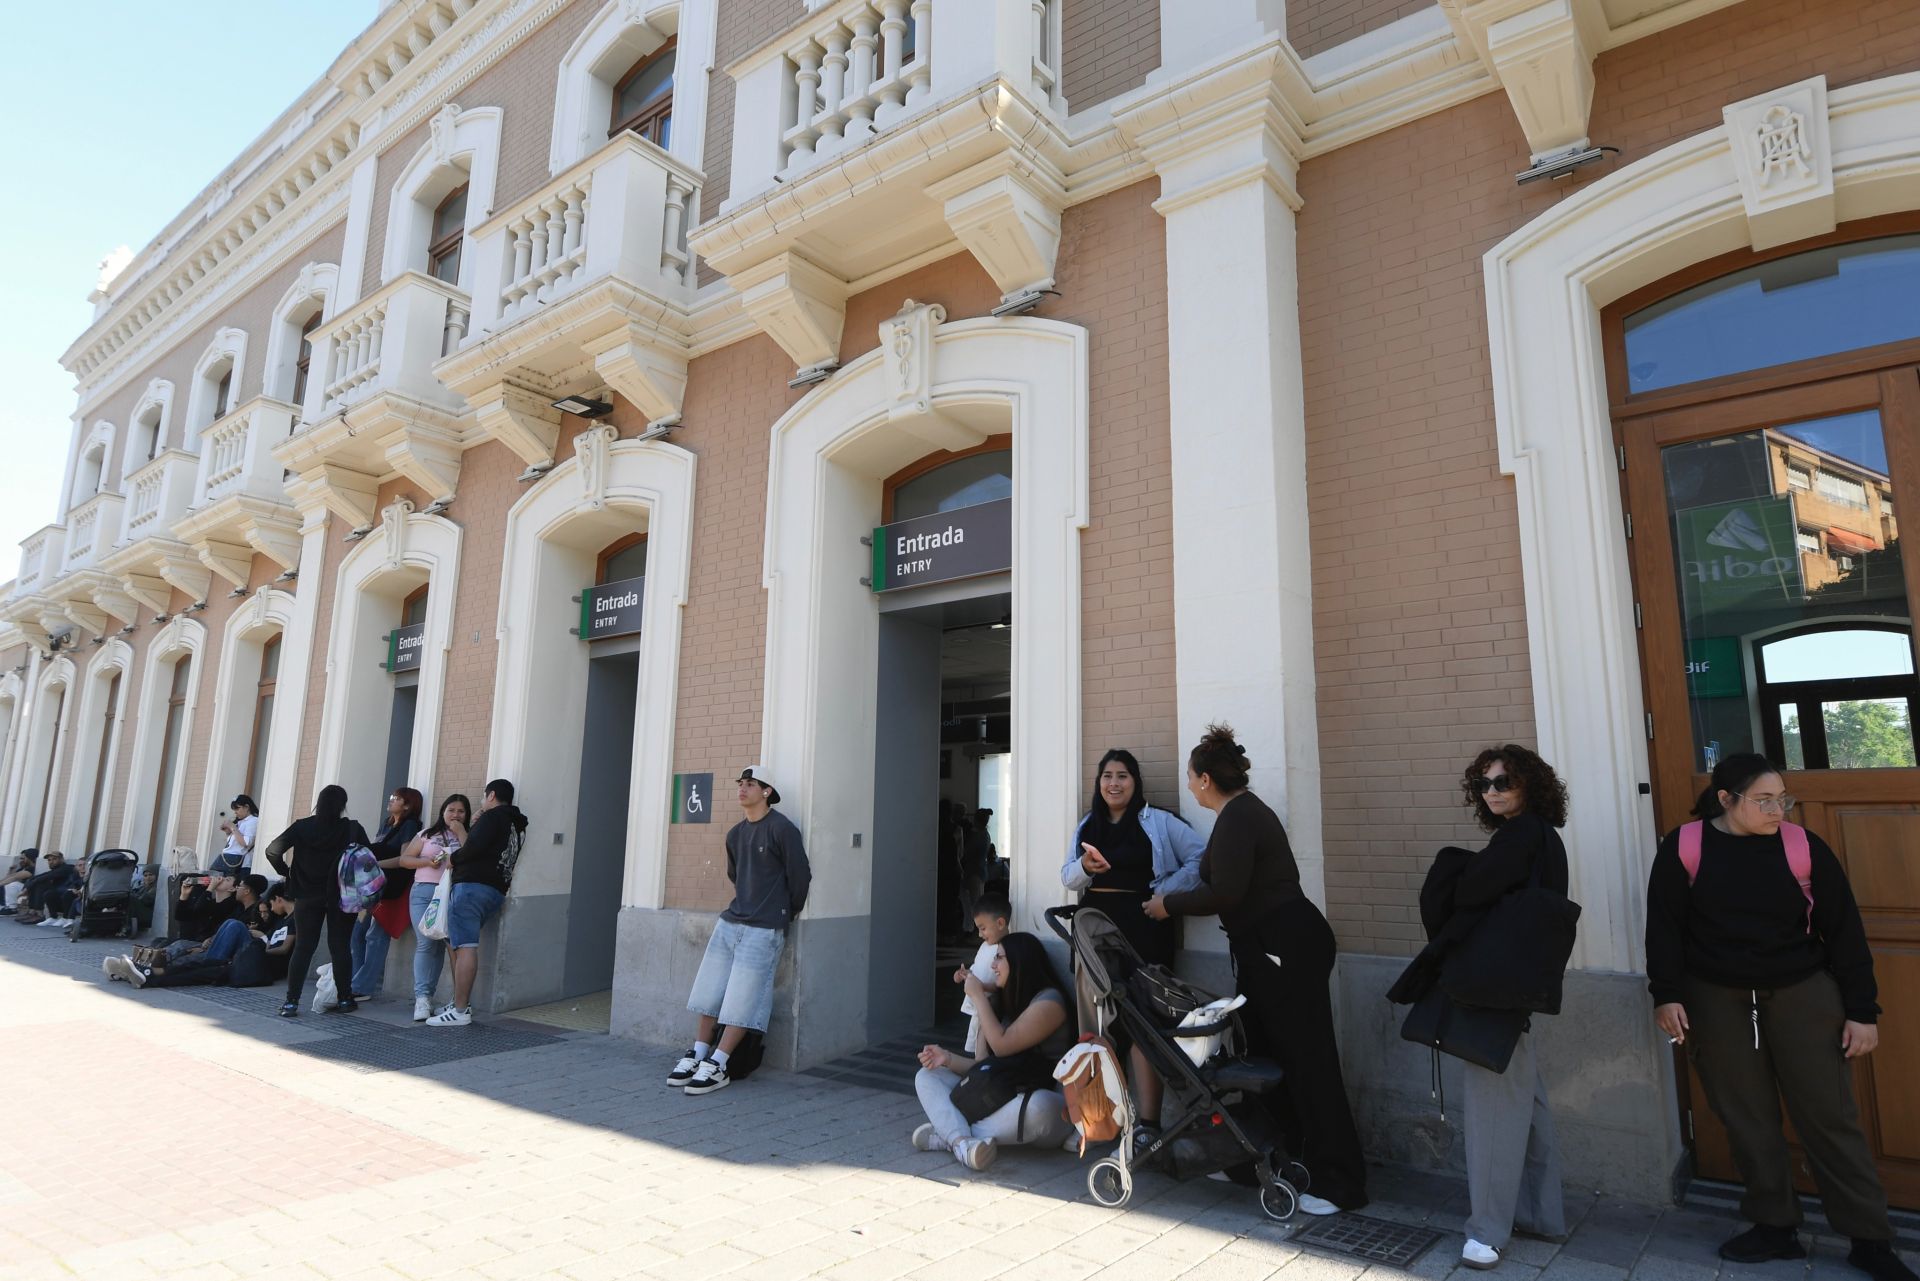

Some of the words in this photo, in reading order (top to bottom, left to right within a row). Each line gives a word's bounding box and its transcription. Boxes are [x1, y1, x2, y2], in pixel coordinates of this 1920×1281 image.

[897, 525, 964, 556] Entrada
[897, 558, 932, 576] ENTRY
[596, 591, 638, 613] Entrada
[595, 615, 618, 629] ENTRY
[397, 653, 412, 663] ENTRY
[1685, 660, 1710, 674] dif
